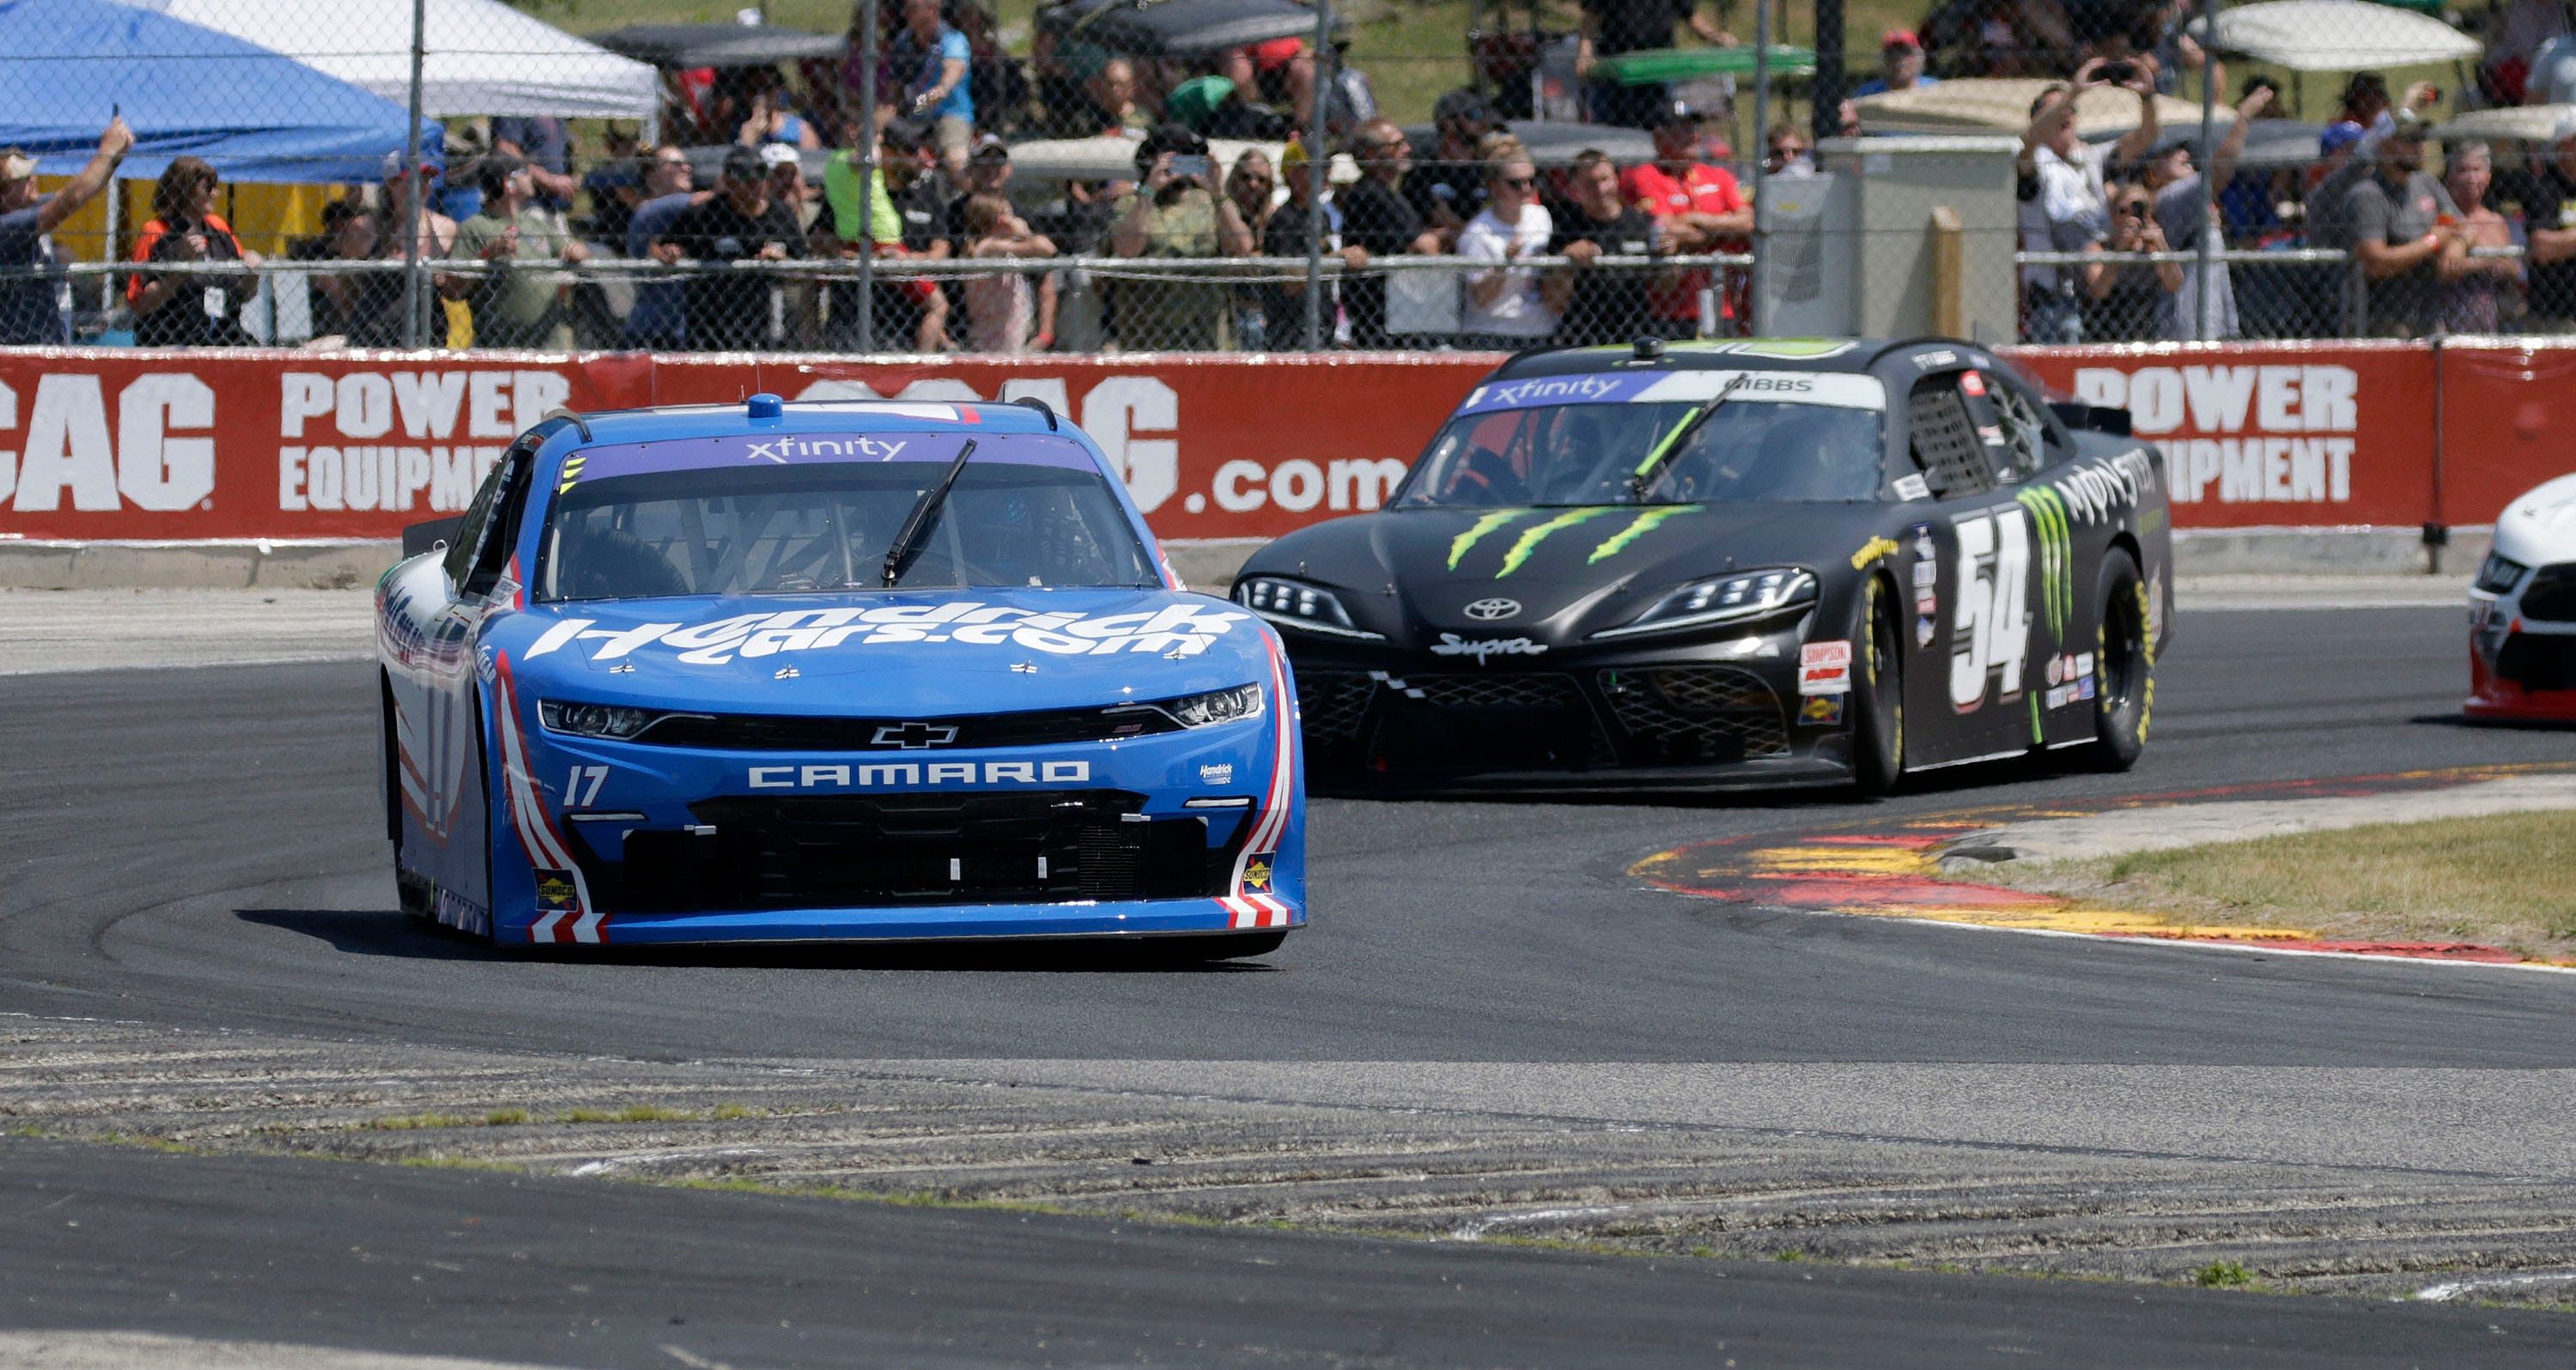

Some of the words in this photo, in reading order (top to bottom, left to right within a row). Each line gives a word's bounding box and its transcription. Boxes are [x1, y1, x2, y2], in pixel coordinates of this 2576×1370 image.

[280, 371, 571, 439] POWER
[1492, 378, 1623, 405] xfinity
[2075, 364, 2358, 433] POWER
[0, 372, 216, 512] AG
[747, 436, 908, 464] xfinity
[795, 375, 1409, 513] G.com
[2154, 438, 2356, 502] IPMENT
[1949, 503, 2032, 714] 54
[523, 603, 1251, 660] Hendrick
[1431, 633, 1547, 665] Supra
[563, 766, 610, 807] 17
[748, 761, 1090, 788] CAMARO
[1200, 763, 1232, 778] Hendrick
[540, 884, 574, 897] SUNOCO
[1243, 868, 1270, 880] SUNOCO
